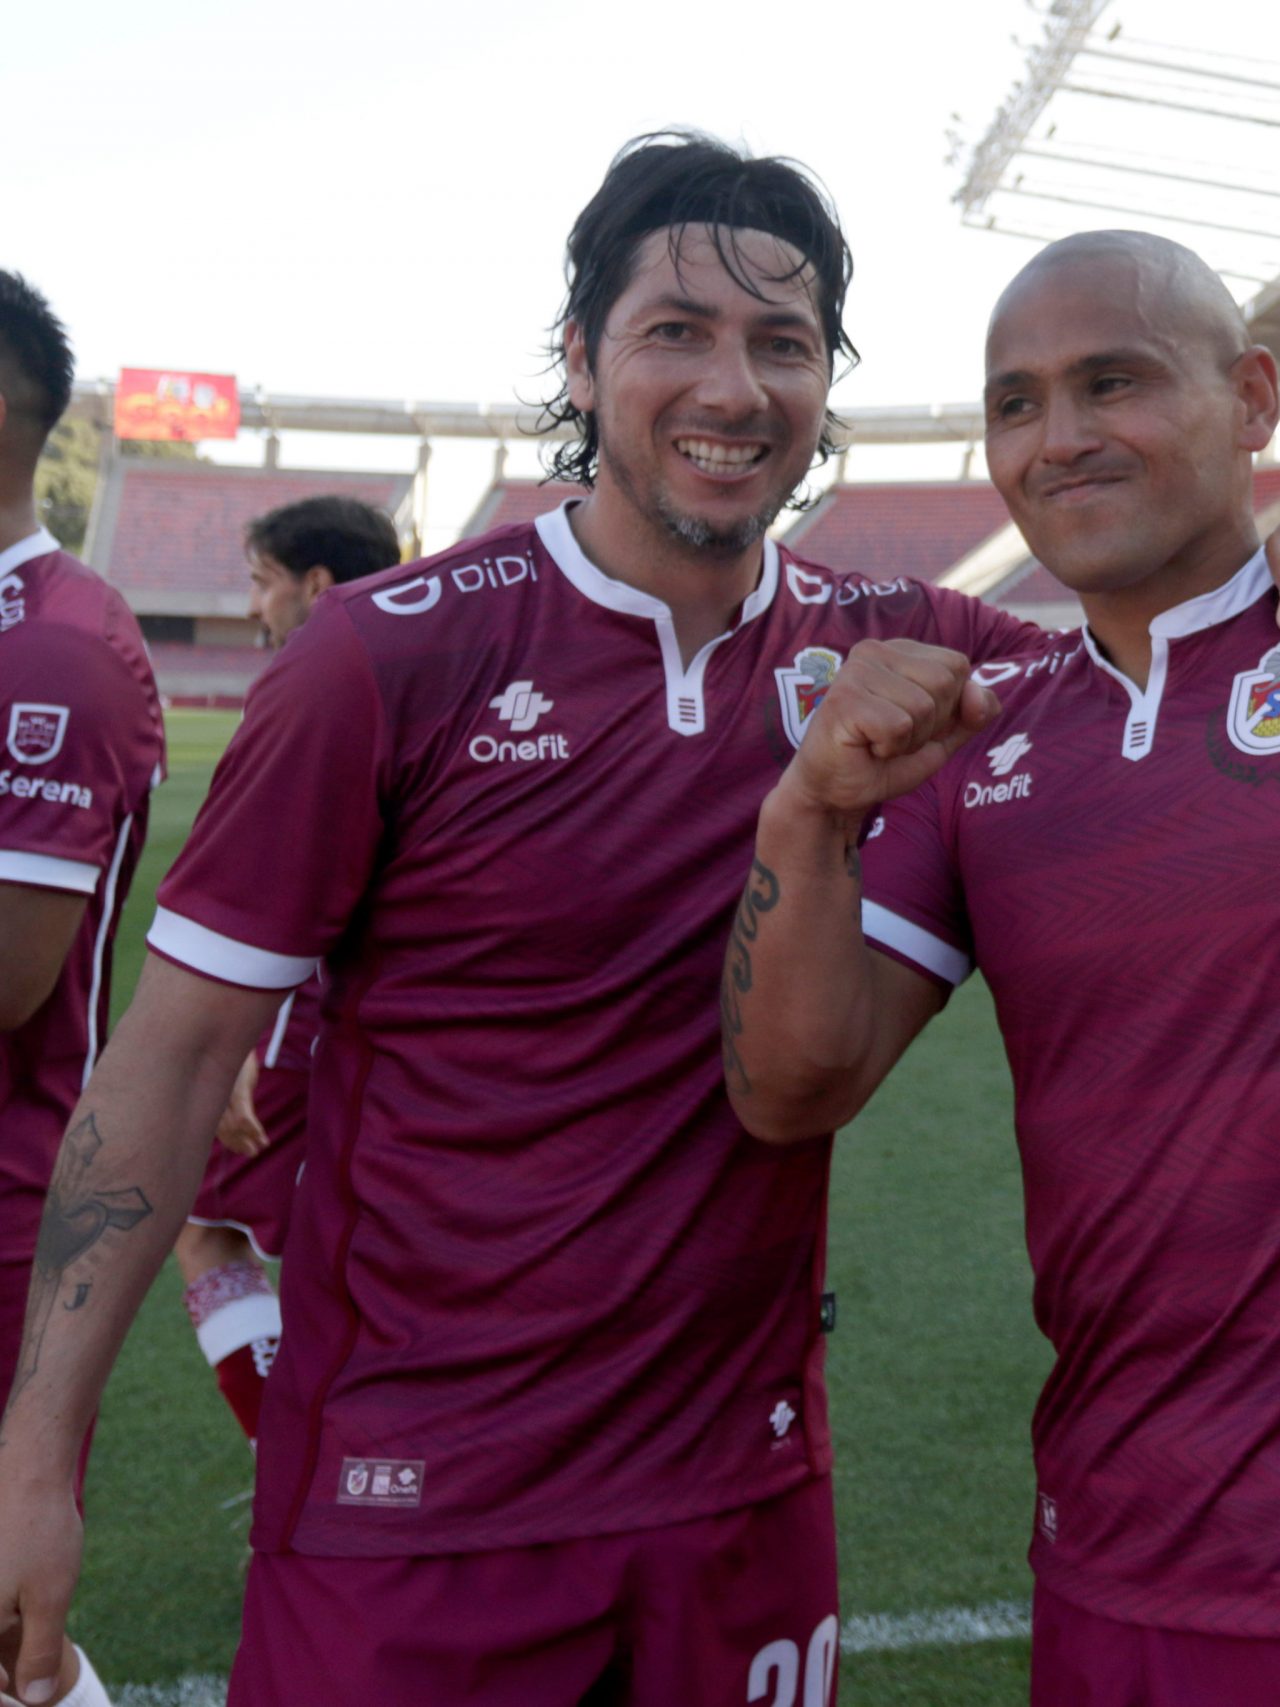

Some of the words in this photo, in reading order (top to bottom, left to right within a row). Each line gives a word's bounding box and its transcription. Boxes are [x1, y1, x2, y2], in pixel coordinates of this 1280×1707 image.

[451, 550, 538, 593] DiDi
[468, 734, 570, 763] Onefit
[964, 773, 1033, 809] Onefit
